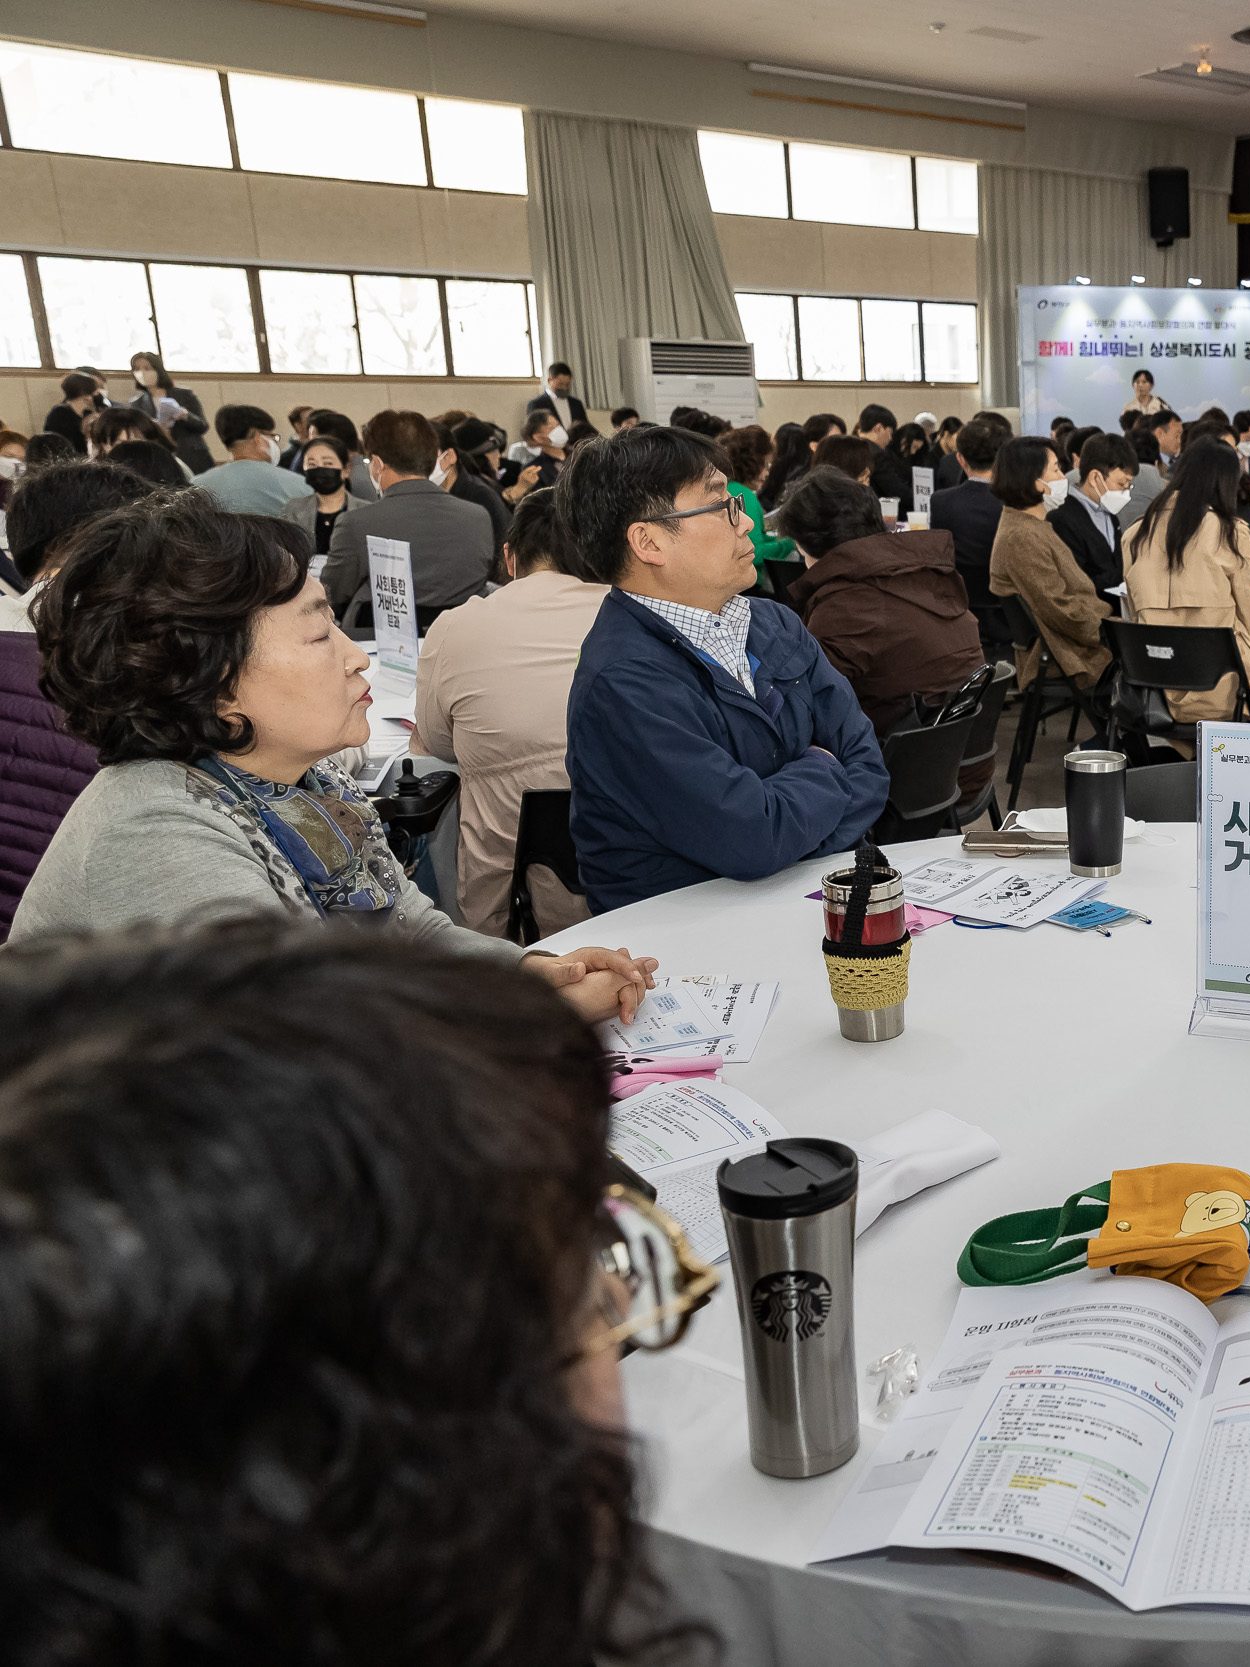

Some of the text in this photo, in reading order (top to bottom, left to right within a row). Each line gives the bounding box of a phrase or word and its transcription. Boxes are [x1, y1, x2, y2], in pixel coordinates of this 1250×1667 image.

[1038, 340, 1073, 357] 함께!
[1079, 340, 1143, 358] 힘내뛰는!
[1150, 342, 1236, 358] 상생복지도시
[376, 574, 406, 597] 사회통합
[377, 593, 409, 615] 거버넌스
[387, 613, 401, 629] 분과
